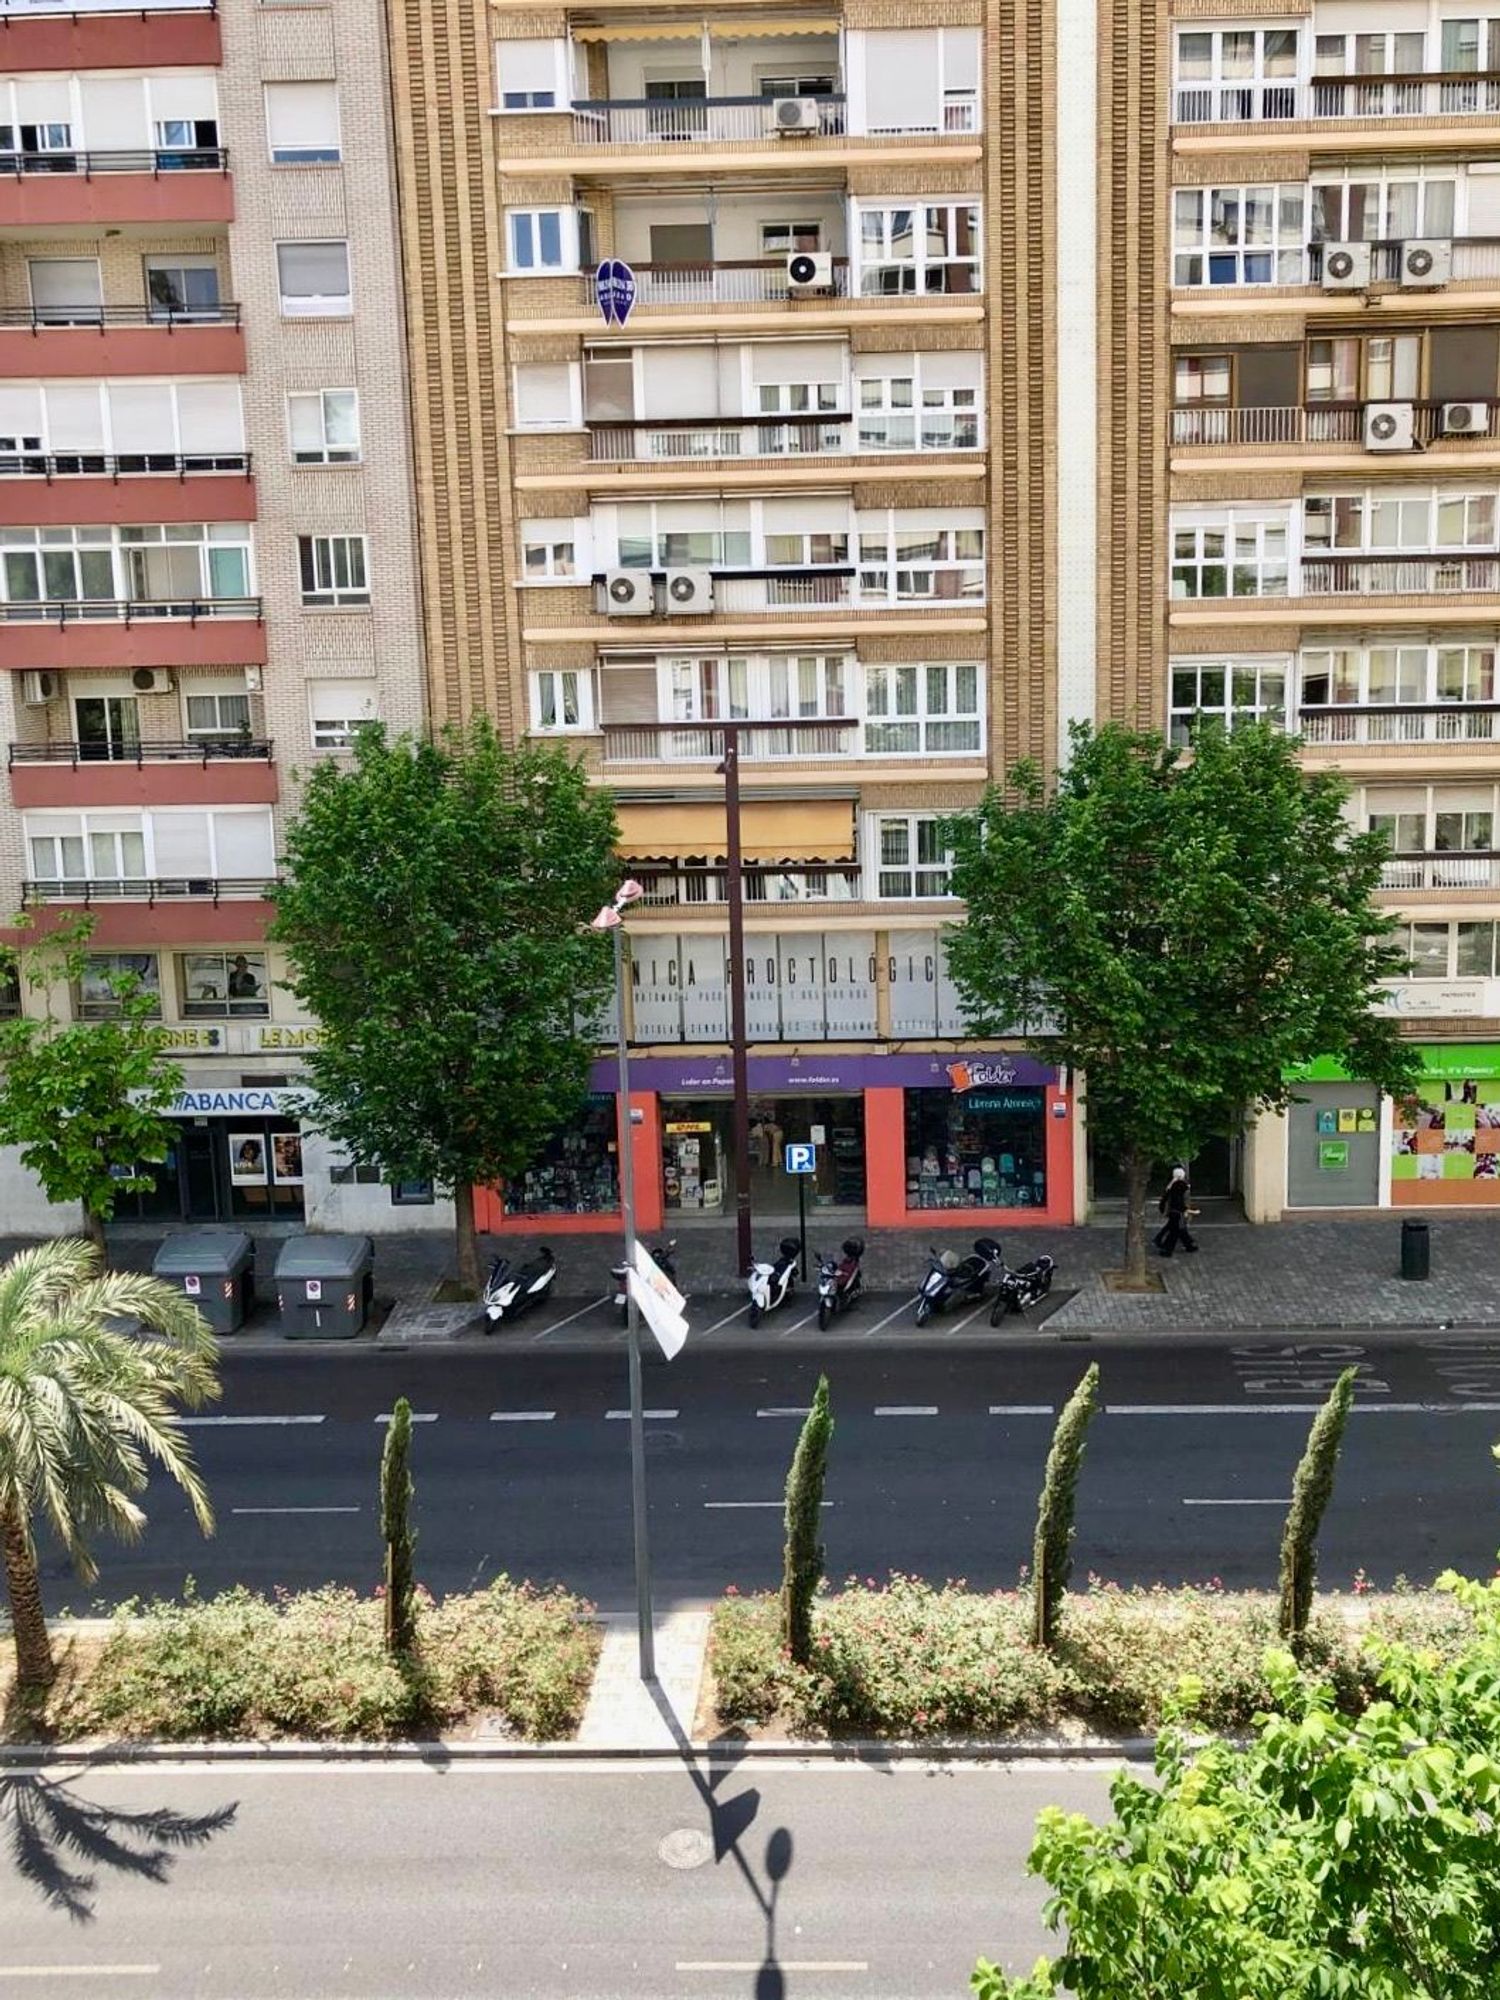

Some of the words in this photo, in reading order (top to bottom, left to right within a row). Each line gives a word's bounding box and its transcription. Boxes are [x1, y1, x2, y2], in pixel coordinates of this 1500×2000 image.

[632, 960, 696, 986] NICA
[726, 952, 934, 984] PROCTOLÓGIC
[183, 1093, 276, 1111] ABANCA
[792, 1147, 810, 1170] P
